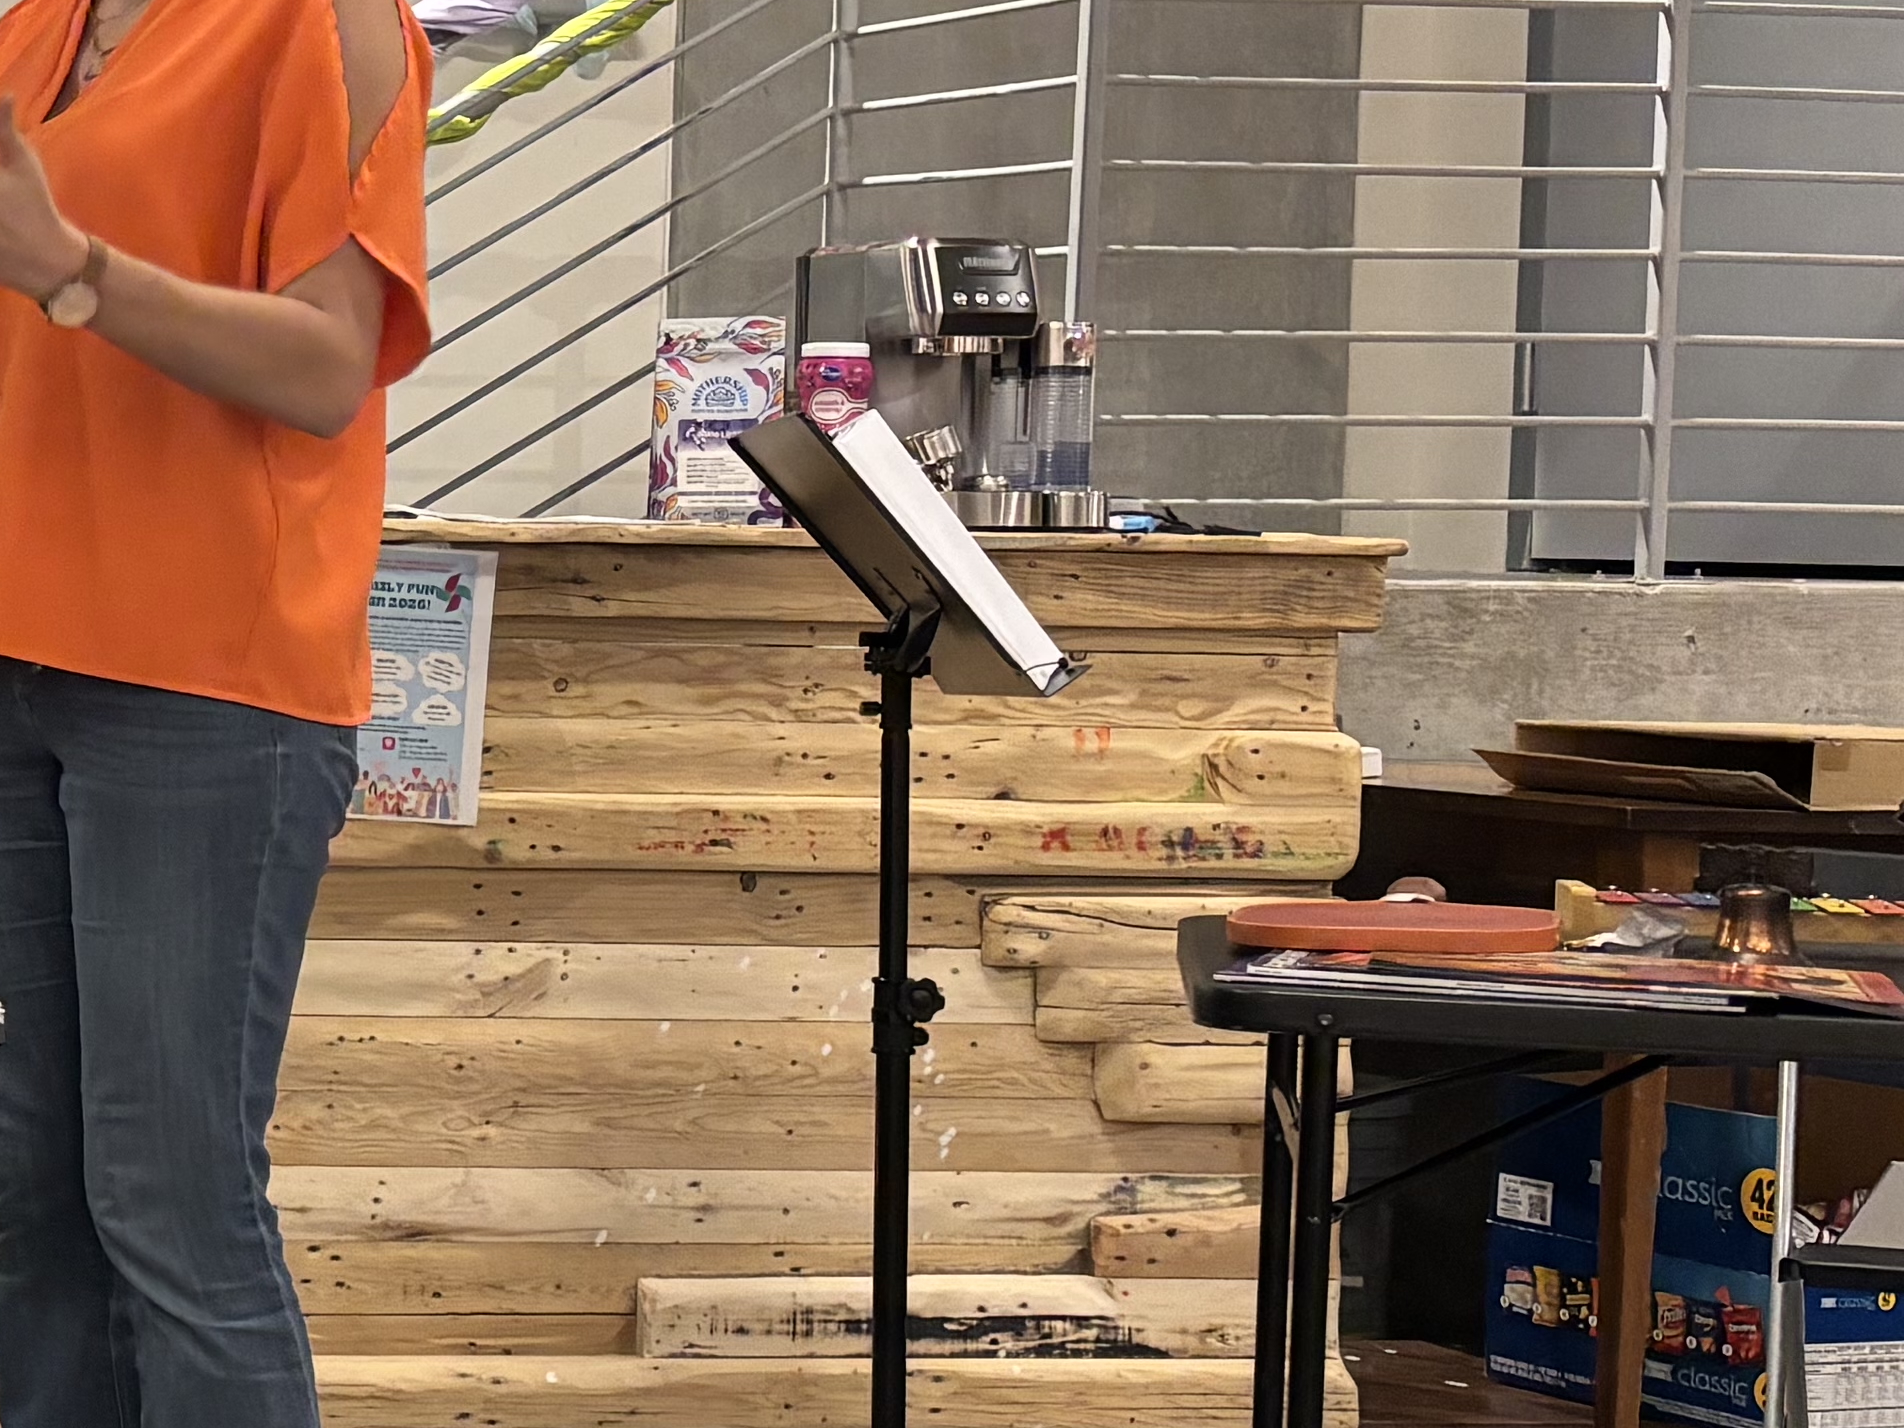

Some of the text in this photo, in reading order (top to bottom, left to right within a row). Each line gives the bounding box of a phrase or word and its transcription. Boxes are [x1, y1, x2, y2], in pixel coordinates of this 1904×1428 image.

[691, 376, 749, 407] MOTHERSHIP
[407, 584, 435, 596] FUN
[1659, 1175, 1733, 1210] assic
[1677, 1367, 1748, 1398] classic
